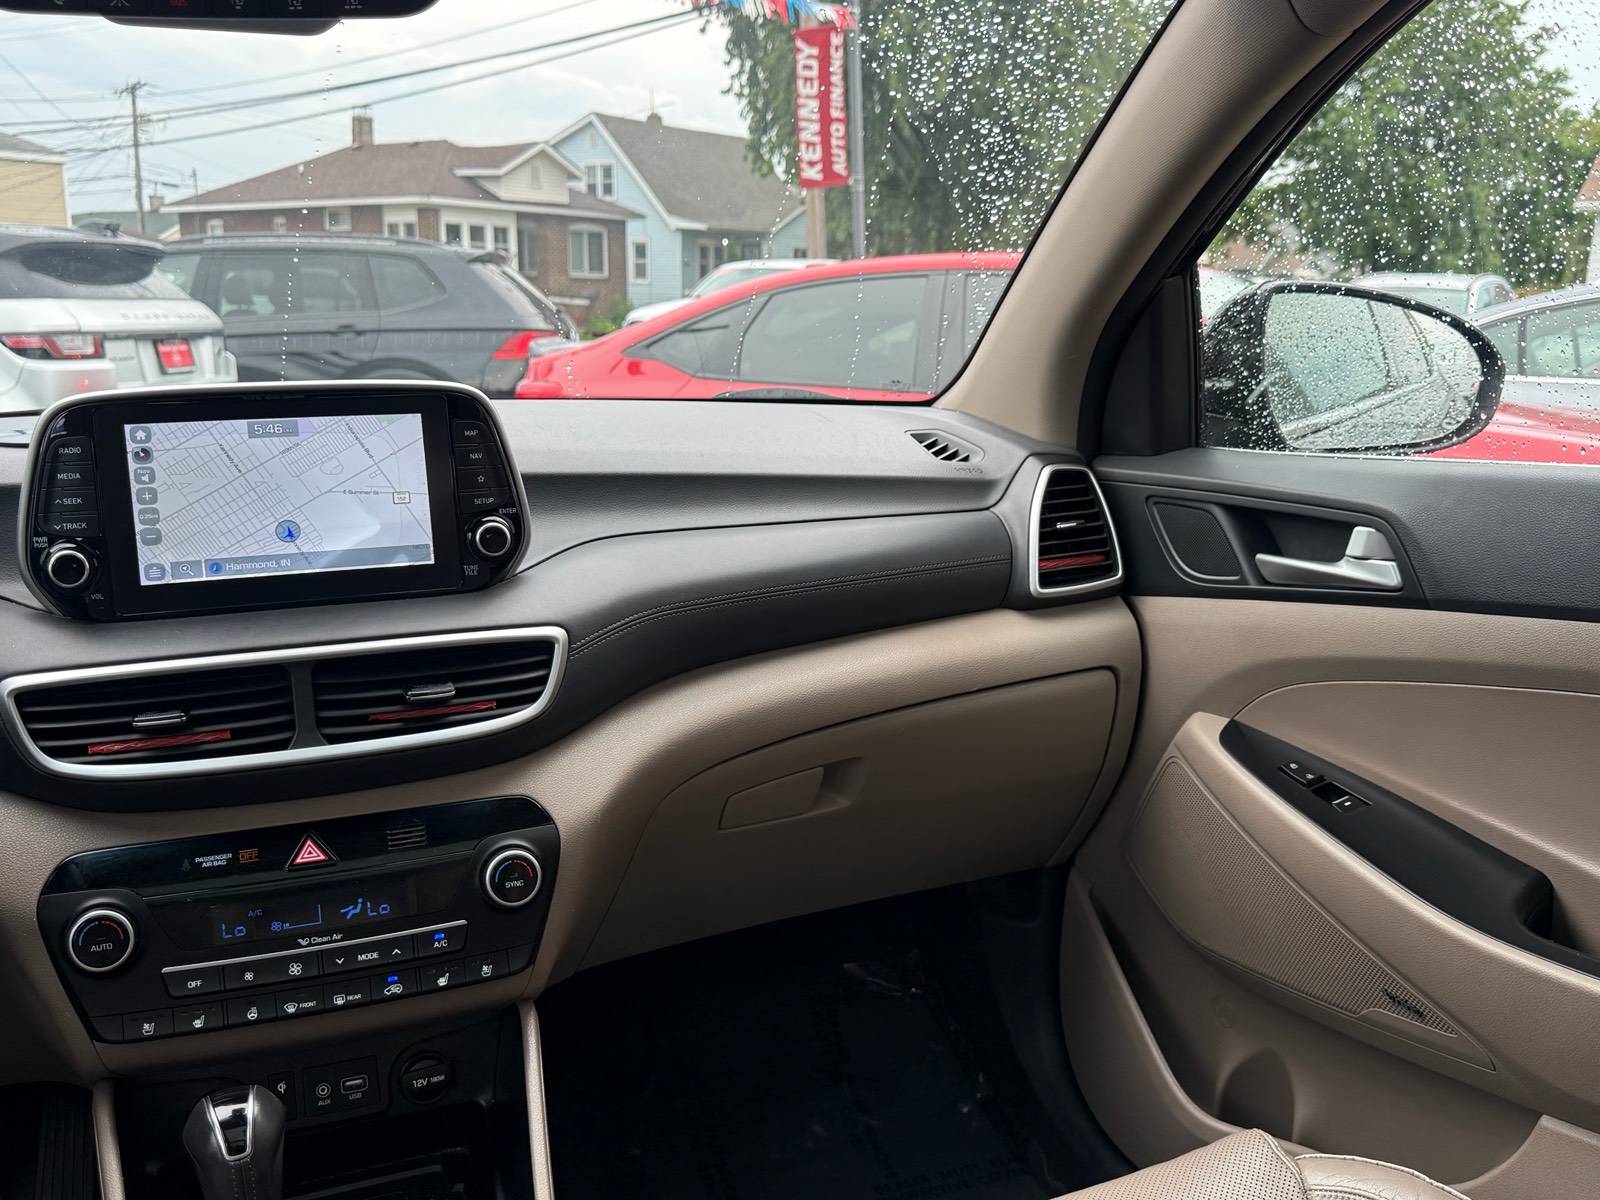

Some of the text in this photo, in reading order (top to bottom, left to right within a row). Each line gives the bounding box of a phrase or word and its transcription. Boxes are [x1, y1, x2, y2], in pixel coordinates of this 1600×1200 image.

[829, 30, 849, 176] AUTO FINANCE
[795, 37, 825, 181] KENNEDY
[254, 423, 283, 435] 5:46
[464, 429, 479, 437] MAP
[58, 446, 82, 454] RADIO
[469, 452, 483, 460] NAV
[57, 472, 81, 480] MEDIA
[63, 497, 83, 505] SEEK
[474, 497, 495, 505] SETUP
[63, 522, 87, 530] TRACK
[226, 558, 291, 571] Hammond, IN
[195, 853, 232, 863] PASSENGER
[239, 851, 258, 861] OFF
[213, 859, 227, 867] BAG
[505, 879, 525, 889] SYNC
[248, 909, 263, 917] A/C
[311, 933, 344, 944] Clean Air
[90, 942, 113, 953] AUTO
[433, 939, 448, 948] A/C
[357, 951, 380, 961] MODE
[187, 979, 202, 989] OFF
[412, 1077, 428, 1088] 12V
[349, 1091, 362, 1099] USB
[317, 1098, 331, 1106] AUX
